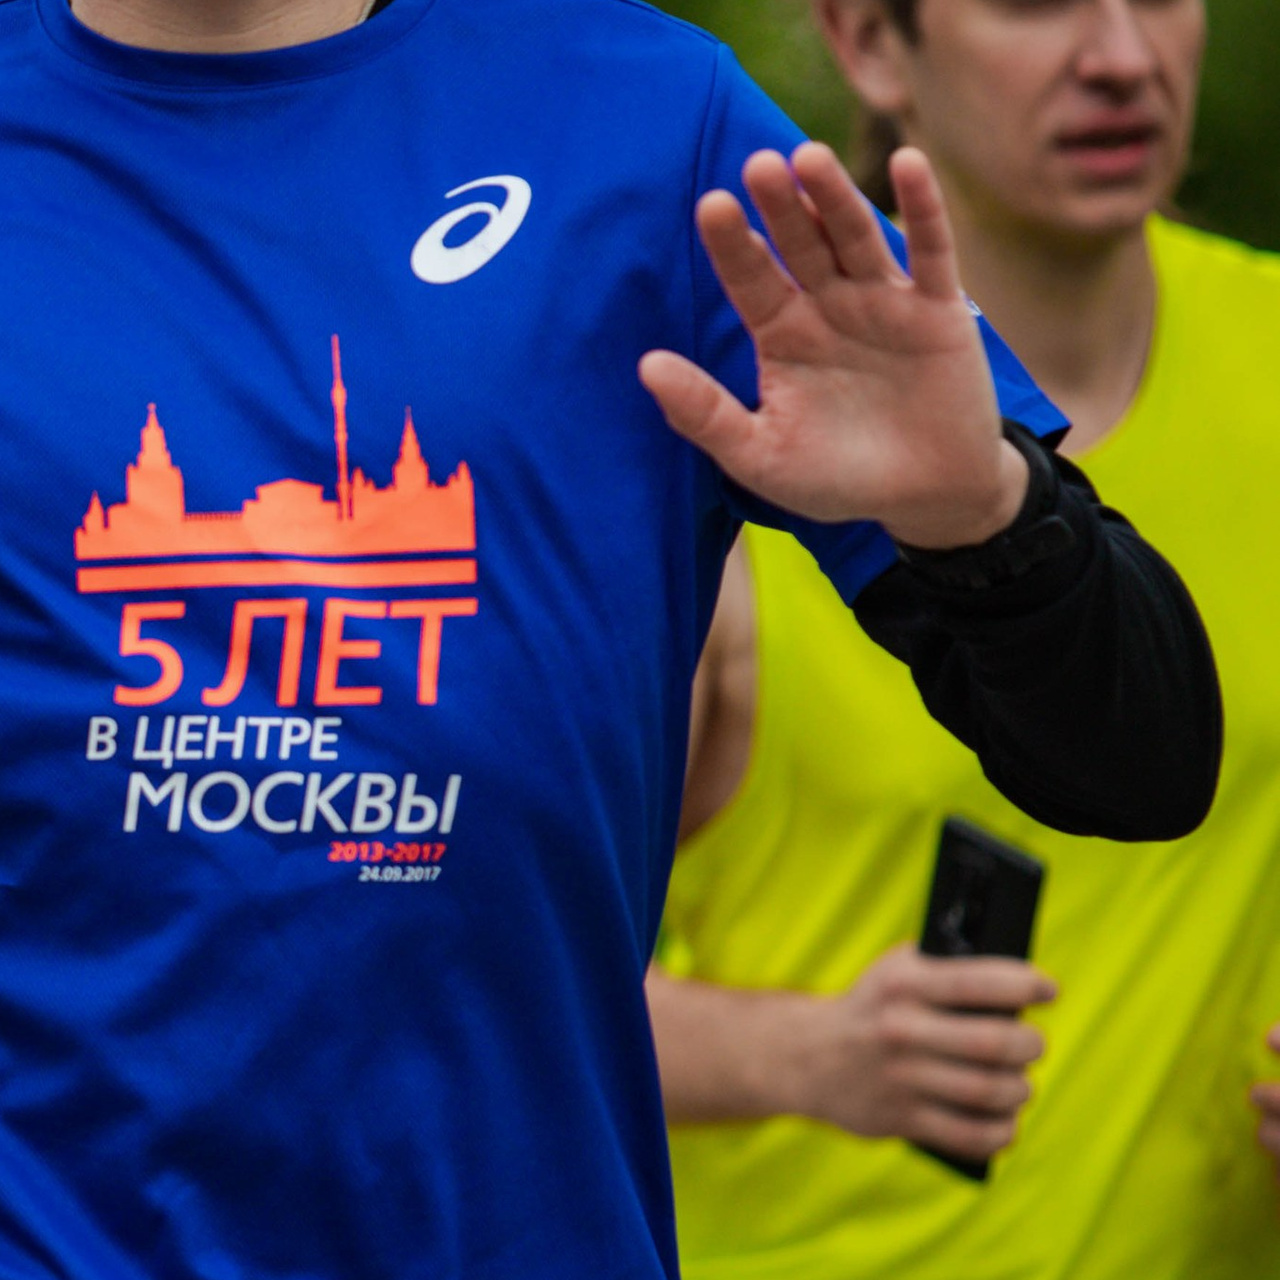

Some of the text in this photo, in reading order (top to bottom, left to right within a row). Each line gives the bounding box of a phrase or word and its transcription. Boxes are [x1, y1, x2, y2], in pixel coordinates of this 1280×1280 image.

[113, 597, 479, 707] 5 ЛЕТ
[86, 715, 342, 769] В ЦЕНТРЕ
[122, 771, 462, 834] МОСКВЫ
[327, 841, 447, 862] 2013-2017
[358, 865, 442, 882] 24.09.2017
